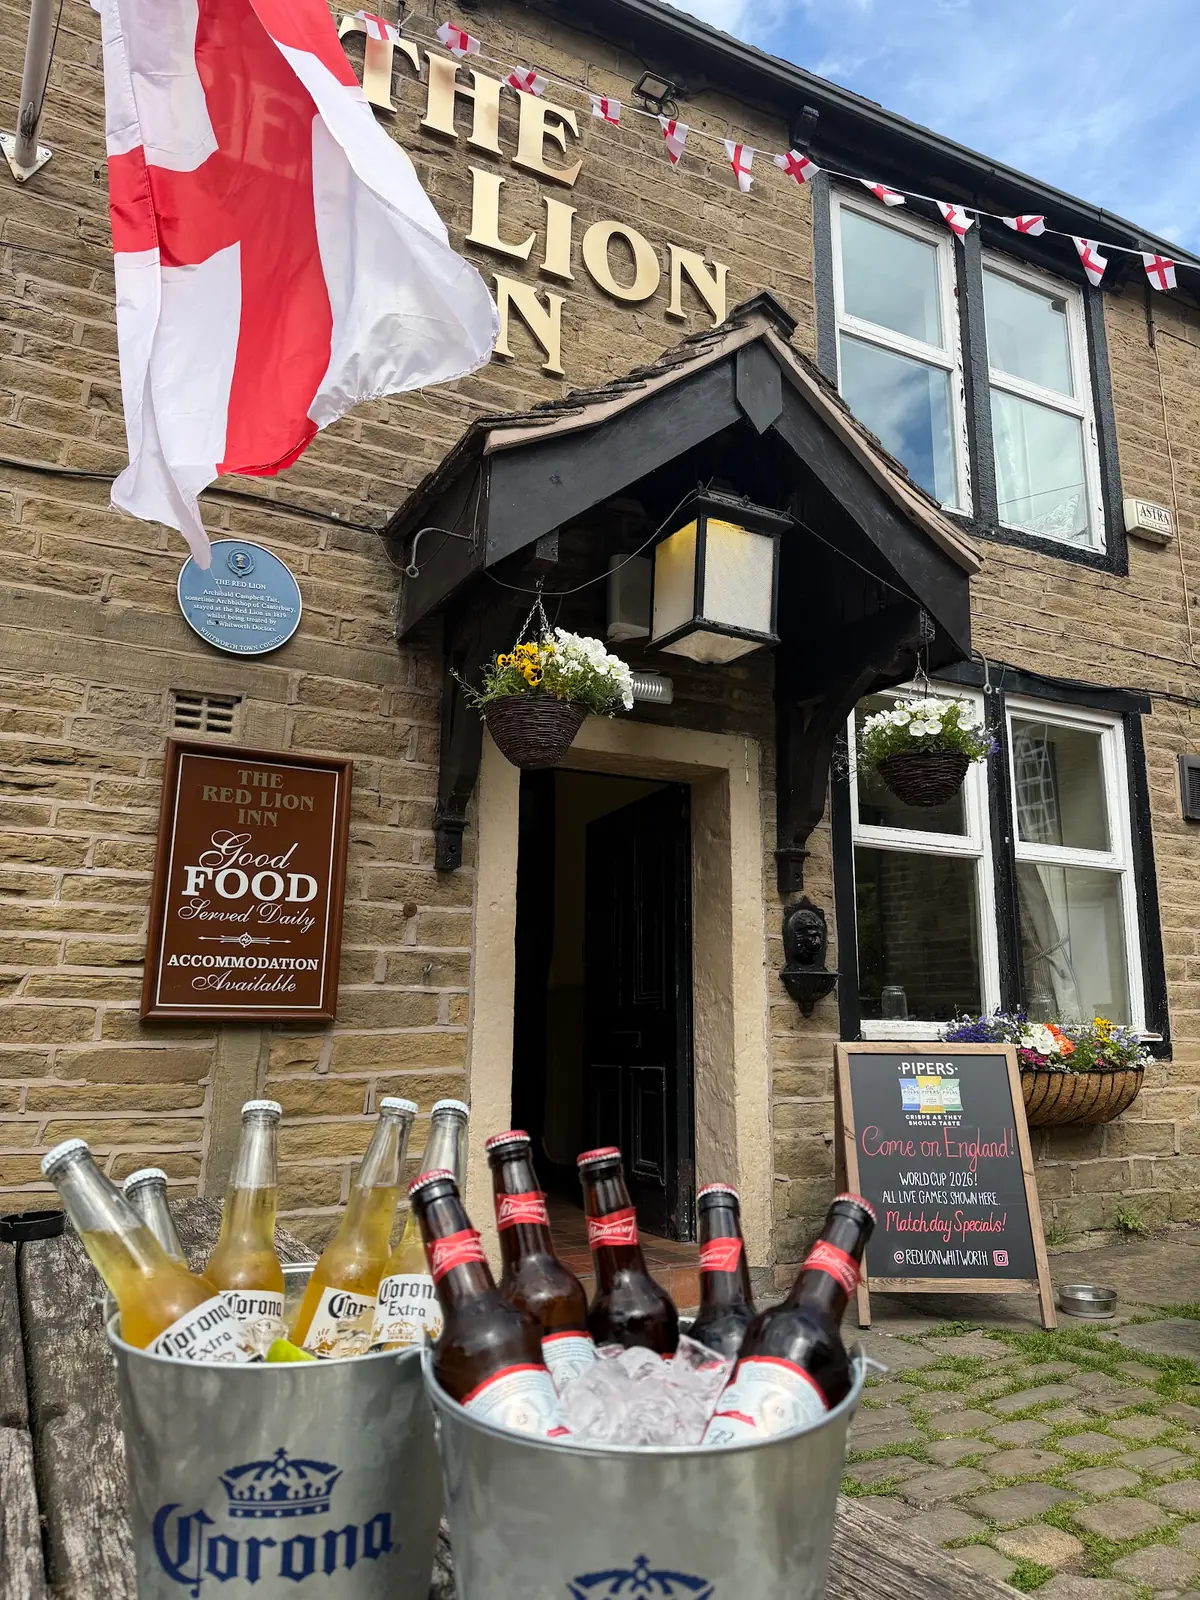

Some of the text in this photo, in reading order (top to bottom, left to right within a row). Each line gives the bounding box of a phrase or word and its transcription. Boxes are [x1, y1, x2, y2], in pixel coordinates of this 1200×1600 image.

[338, 16, 583, 187] THE
[465, 166, 729, 328] LION
[1140, 505, 1170, 525] ASTRA
[203, 589, 234, 598] Archibald
[235, 592, 264, 602] Campbell
[232, 580, 247, 588] RED
[248, 582, 267, 590] LION
[184, 595, 215, 603] sometime
[216, 598, 251, 608] Archbishop
[219, 621, 251, 630] Whitworth
[227, 614, 245, 622] being
[246, 616, 268, 624] treated
[269, 618, 277, 626] by
[200, 626, 238, 650] WHITWORTH
[259, 634, 285, 649] COUNCIL
[237, 770, 284, 789] THE
[202, 785, 315, 812] RED LION
[237, 808, 278, 827] INN
[199, 829, 299, 871] Good
[181, 866, 318, 903] FOOD
[177, 898, 316, 933] Served Daily
[167, 954, 319, 971] ACCOMMODATION
[191, 969, 297, 992] Available
[862, 1126, 1015, 1172] Come on England!
[899, 1172, 978, 1187] WORLD CUP 2026!
[882, 1190, 896, 1204] ALL
[898, 1190, 916, 1204] LIVE
[918, 1190, 947, 1205] GAMES
[950, 1191, 977, 1205] SHOWN
[953, 1210, 1007, 1243] Specials!
[379, 1279, 436, 1305] Coron
[388, 1300, 426, 1318] Extra
[154, 1305, 232, 1358] Corona
[153, 1503, 394, 1598] Corona
